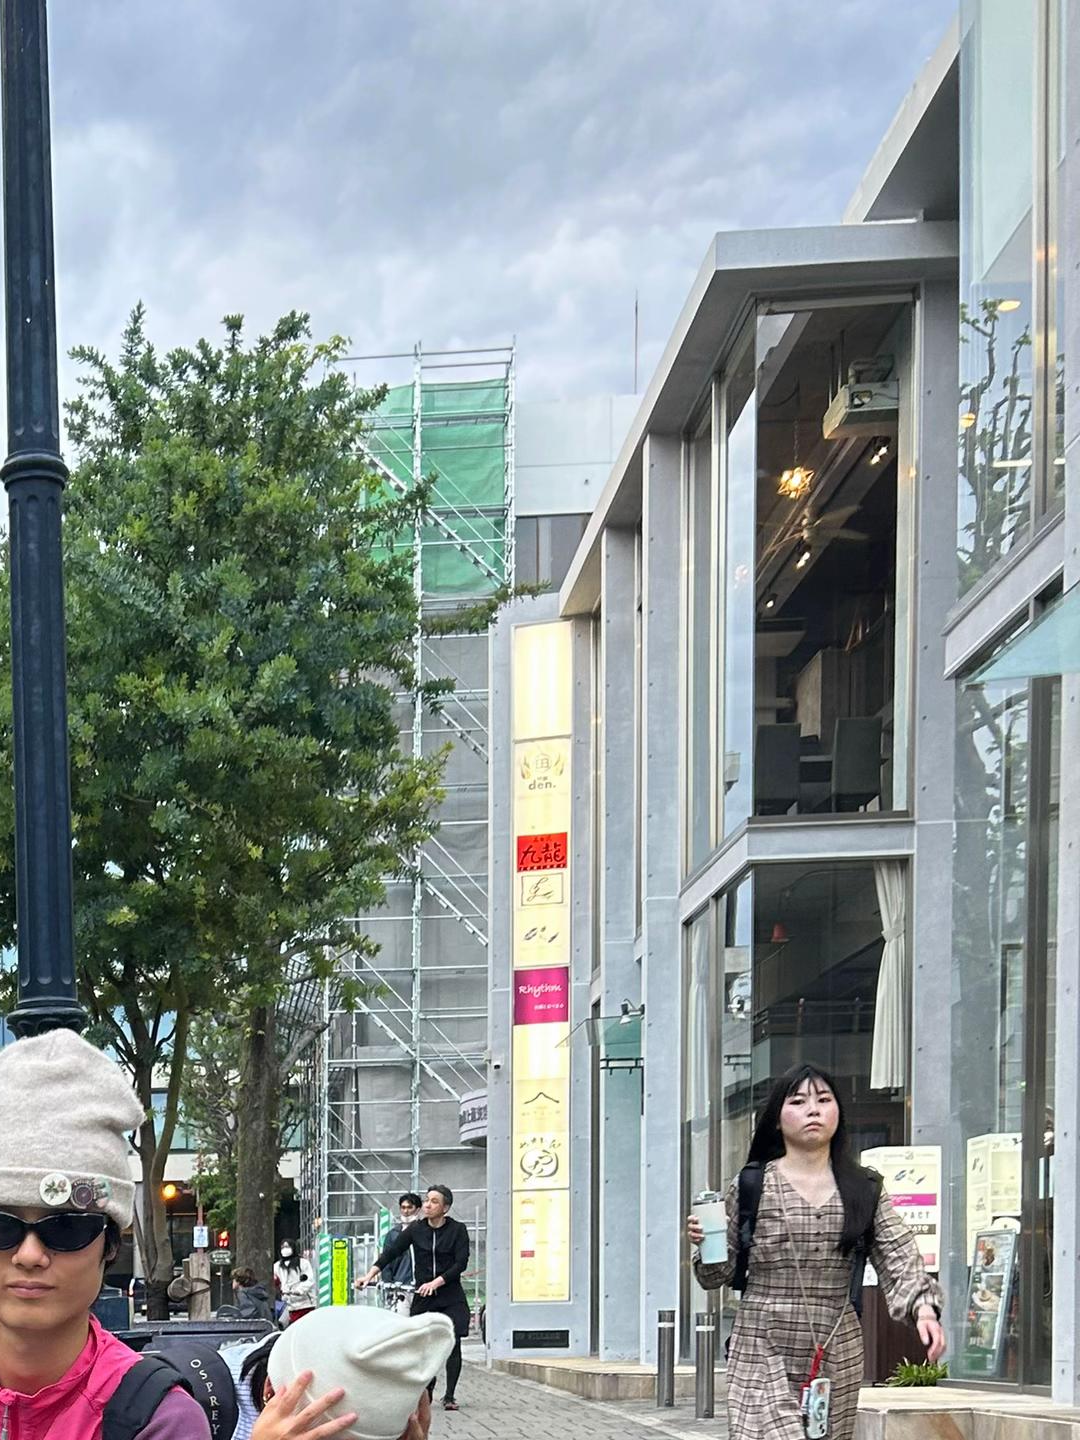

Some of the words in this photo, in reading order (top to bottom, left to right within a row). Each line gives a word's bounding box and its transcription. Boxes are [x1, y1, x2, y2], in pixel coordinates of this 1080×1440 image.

[519, 842, 565, 865] 九龍
[518, 982, 562, 998] Rhythm
[190, 1359, 220, 1435] OSPREY
